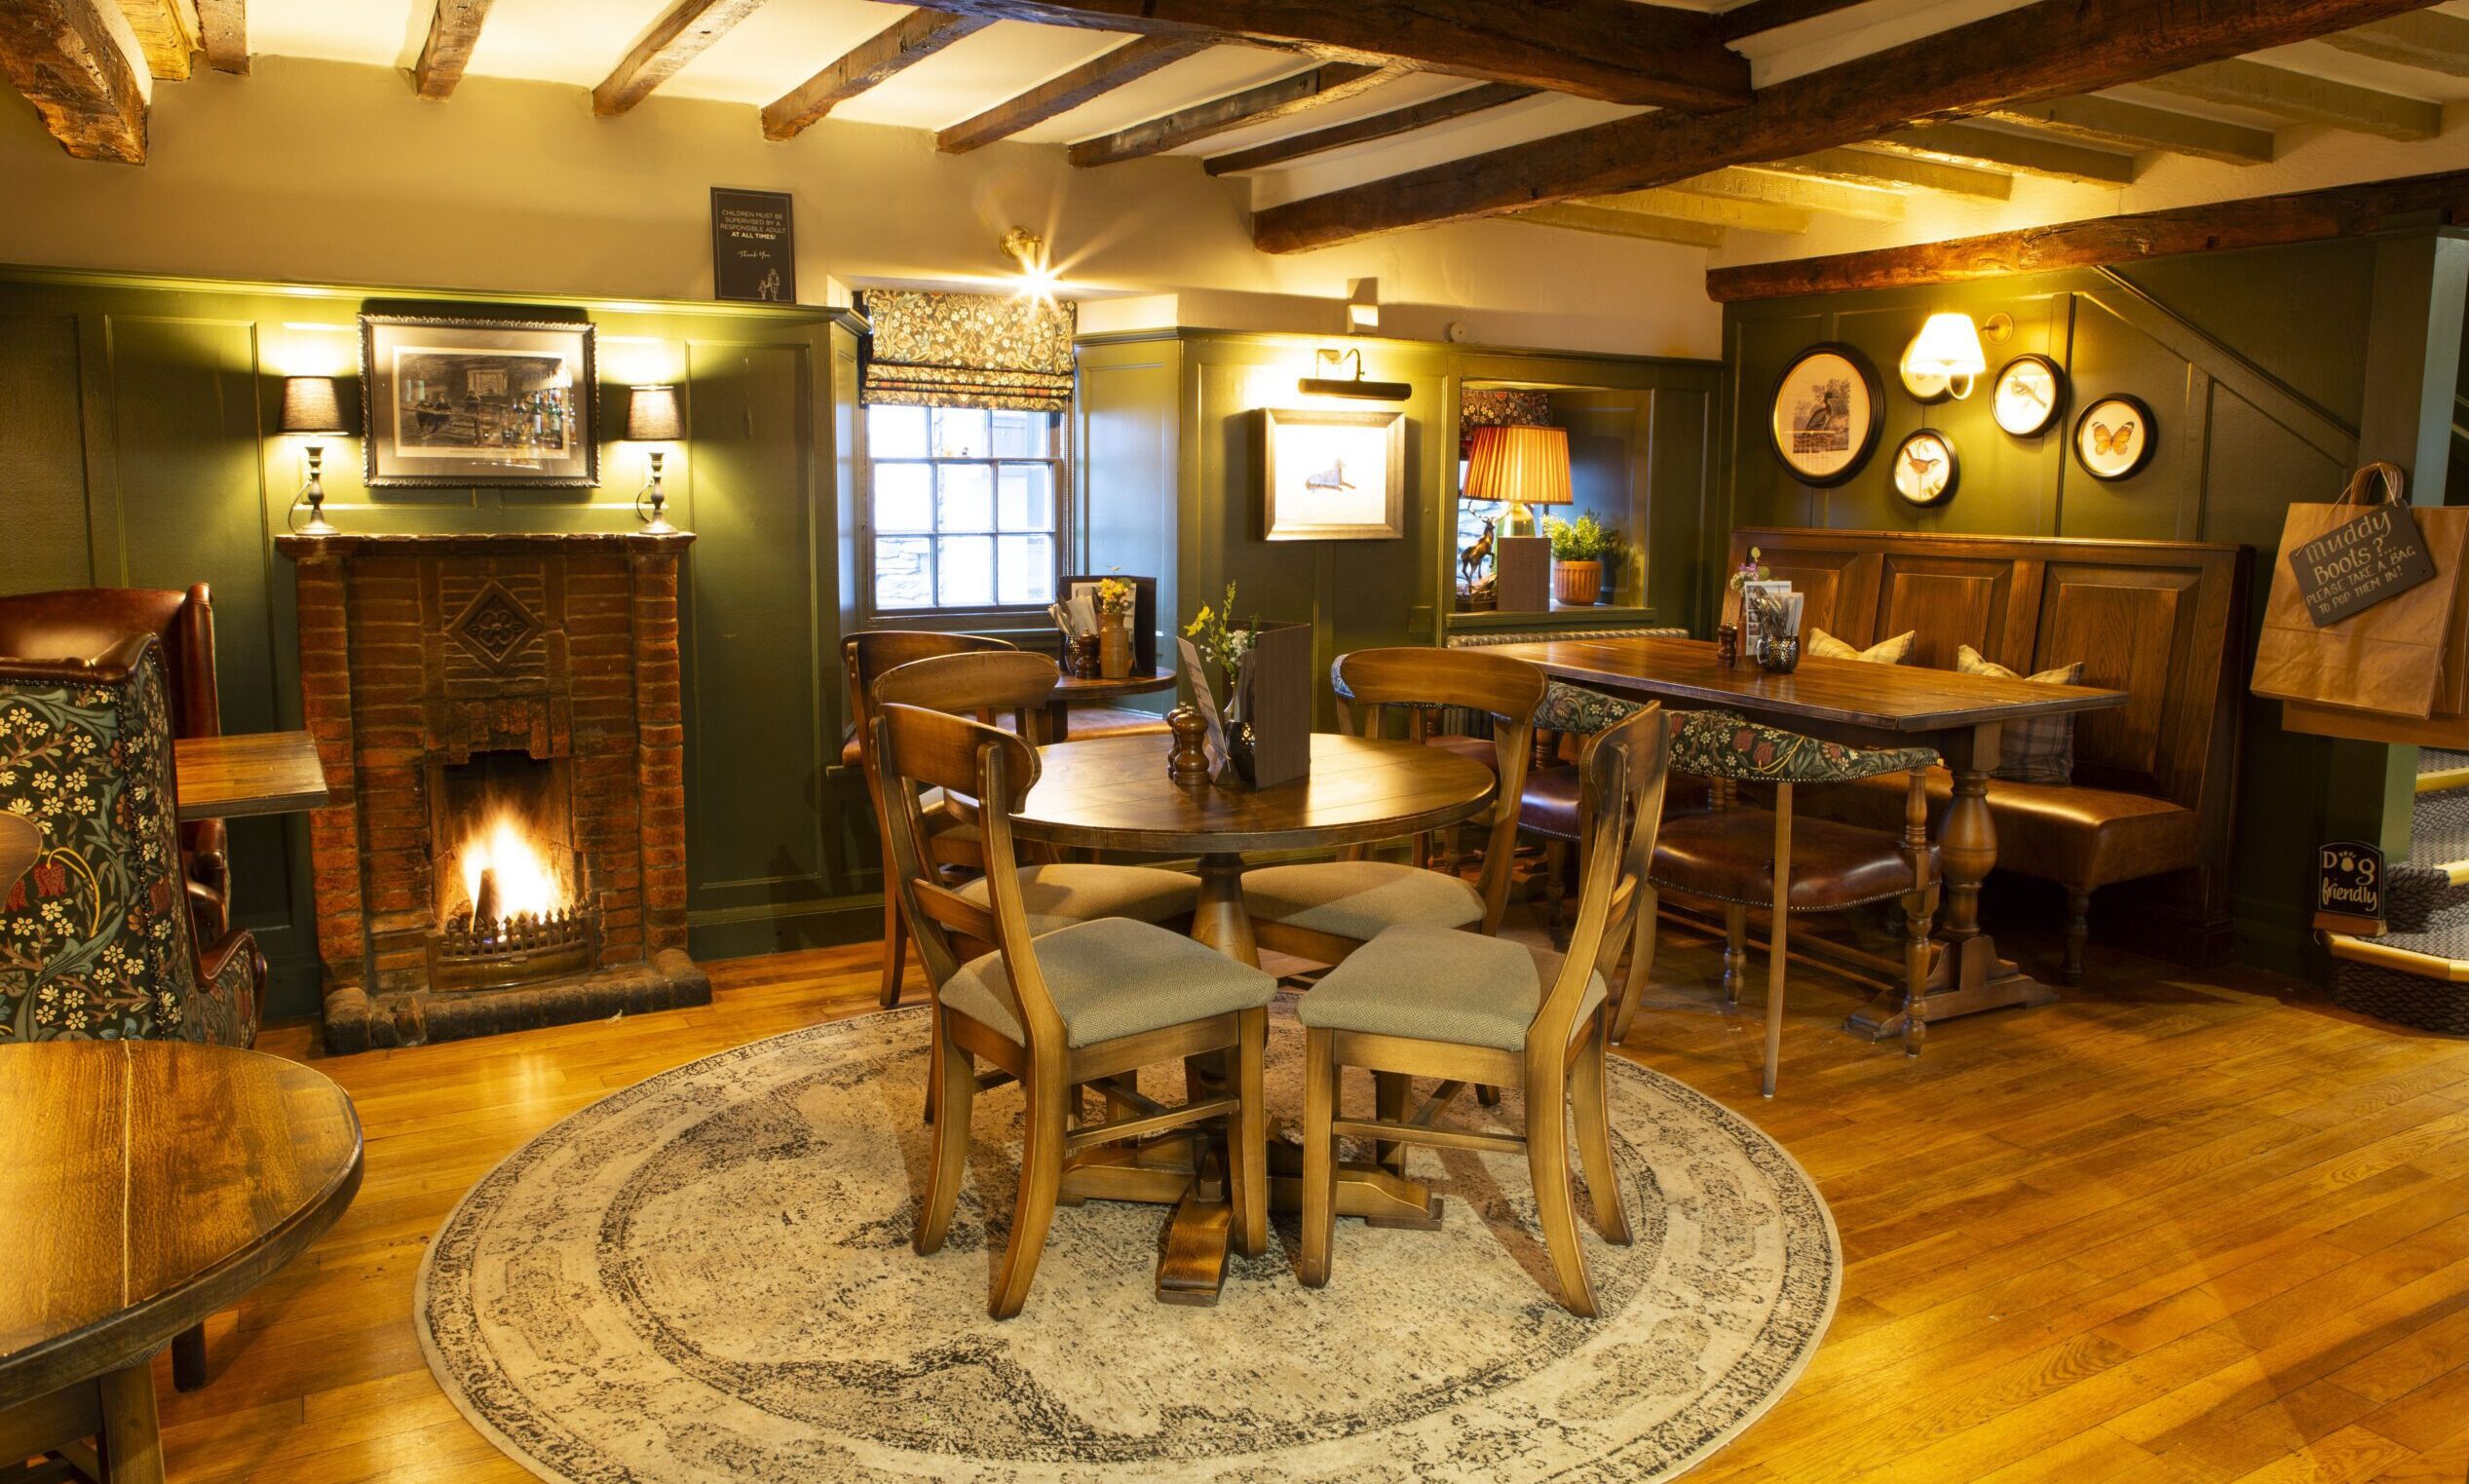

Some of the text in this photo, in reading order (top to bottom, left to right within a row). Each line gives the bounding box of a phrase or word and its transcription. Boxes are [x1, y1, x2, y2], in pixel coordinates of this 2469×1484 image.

[720, 223, 765, 232] RESPONSIBLE
[759, 250, 772, 260] You
[2306, 546, 2416, 606] PLEASE TAKE A BAG
[2318, 565, 2404, 614] TO POP THEM IN!
[2322, 876, 2377, 912] friendly
